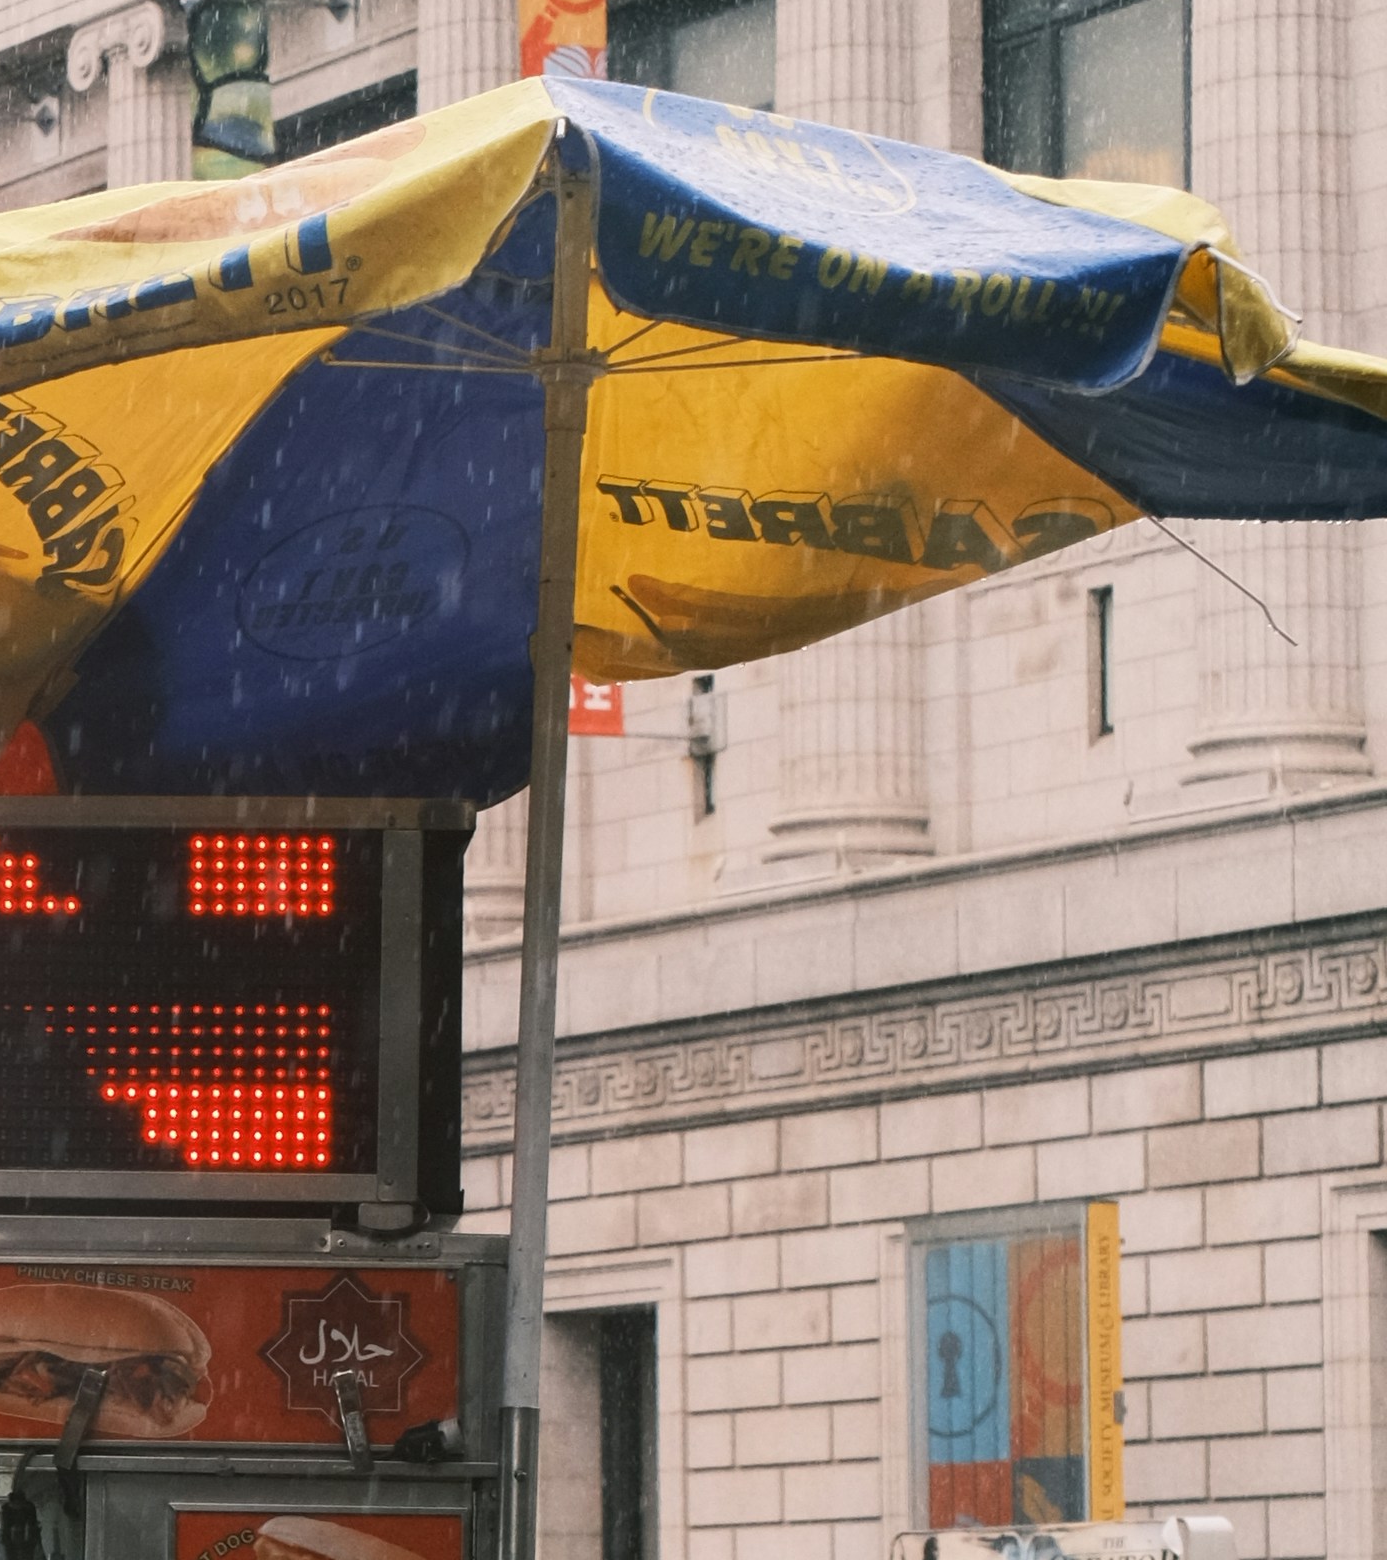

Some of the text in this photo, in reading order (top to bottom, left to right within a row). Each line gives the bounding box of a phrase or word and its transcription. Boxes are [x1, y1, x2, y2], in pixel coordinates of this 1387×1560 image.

[639, 210, 801, 291] WE'RE
[817, 244, 887, 302] ON
[903, 270, 935, 306] A
[946, 268, 1053, 322] ROLL
[266, 276, 352, 317] 2017
[17, 1265, 194, 1293] PHILLY CHEESE STEAK
[1095, 1233, 1110, 1307] LIBRARY
[299, 1318, 395, 1365] حلال
[1100, 1333, 1114, 1416] MUSEUM
